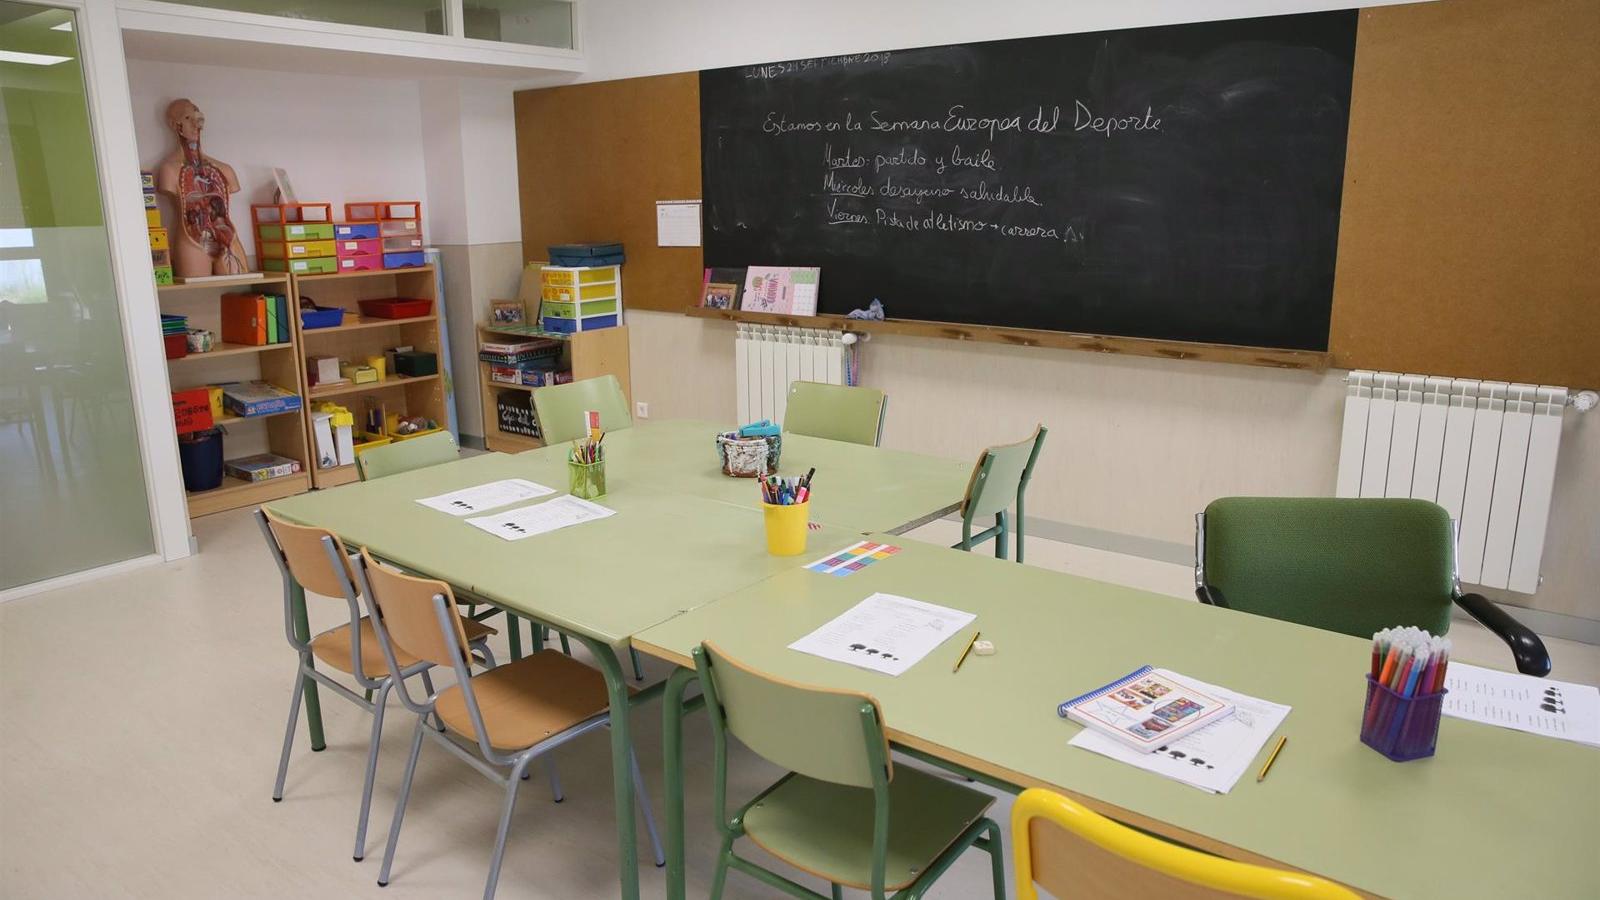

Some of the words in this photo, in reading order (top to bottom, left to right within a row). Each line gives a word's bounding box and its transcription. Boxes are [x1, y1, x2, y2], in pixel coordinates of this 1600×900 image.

[762, 111, 822, 136] Estamos
[824, 121, 841, 132] en
[846, 112, 863, 132] la
[870, 110, 941, 132] Semana
[943, 104, 1022, 142] Europea
[1027, 106, 1060, 133] del
[874, 147, 927, 173] partido
[935, 156, 948, 174] y
[951, 144, 997, 171] baile
[879, 175, 955, 205] desayuno
[905, 215, 919, 231] de
[922, 209, 988, 231] atletismo
[1000, 224, 1060, 239] carrera
